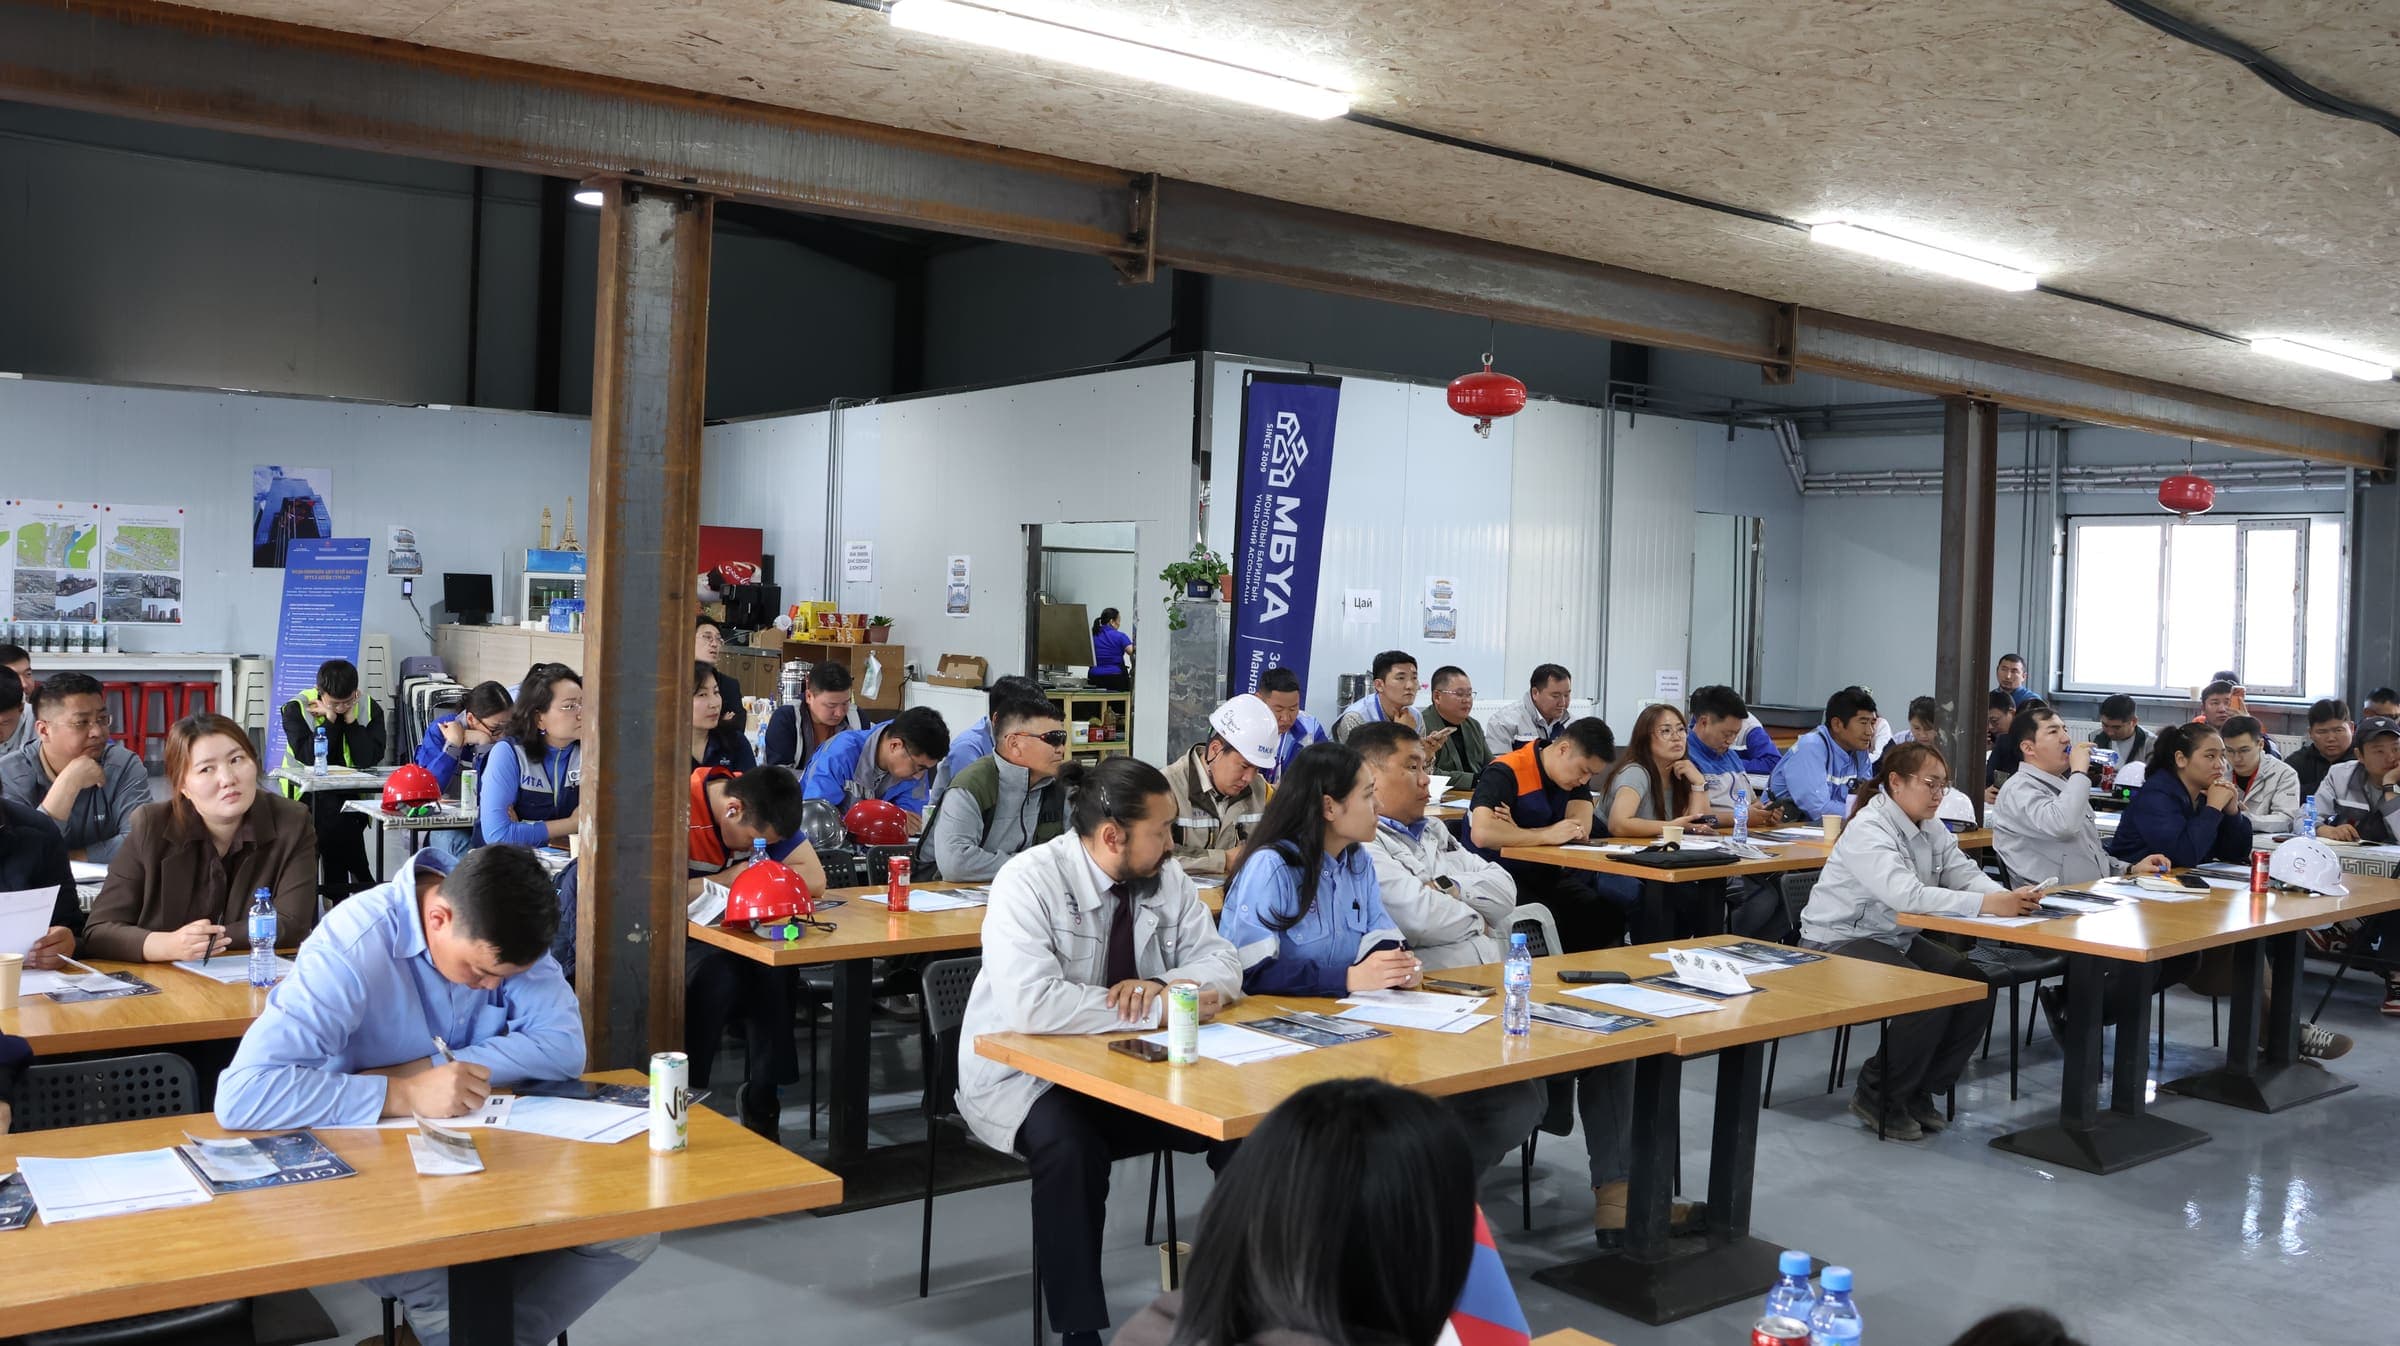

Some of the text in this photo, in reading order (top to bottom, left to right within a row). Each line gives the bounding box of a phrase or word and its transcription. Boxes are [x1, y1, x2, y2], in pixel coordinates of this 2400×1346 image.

[1260, 423, 1274, 473] SINCE 2009
[1250, 494, 1273, 602] МОНГОЛЫН БАРИЛГЫН
[1354, 597, 1373, 610] Цай
[1248, 650, 1264, 694] Манла
